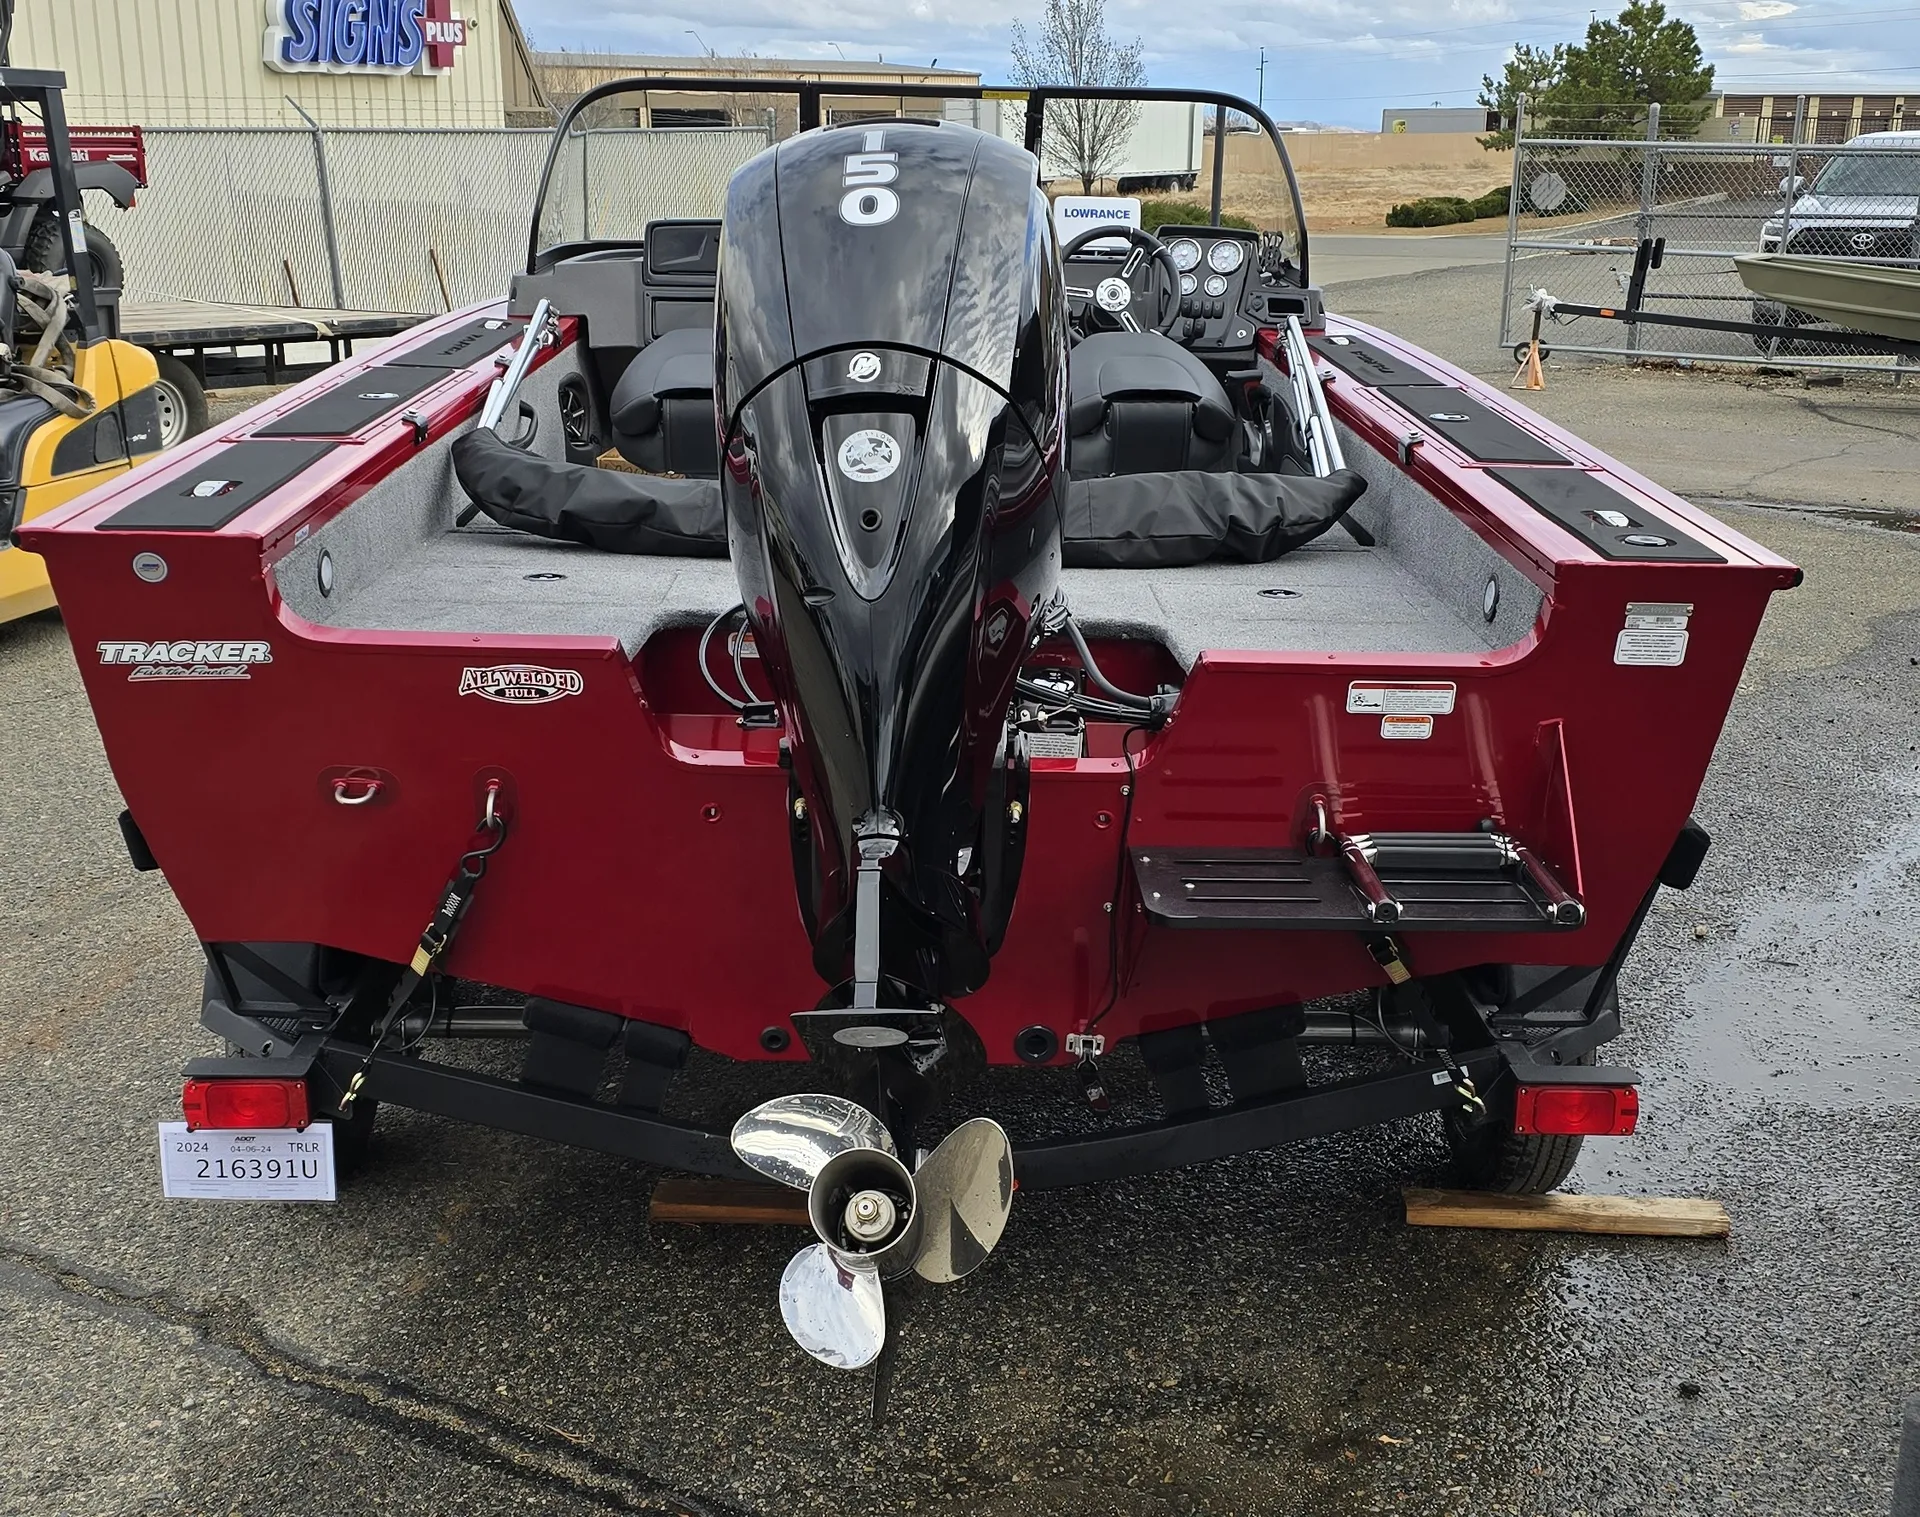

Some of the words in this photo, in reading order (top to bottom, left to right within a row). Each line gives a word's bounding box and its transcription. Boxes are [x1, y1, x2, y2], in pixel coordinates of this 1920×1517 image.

[284, 0, 424, 67] SIGNS
[425, 21, 464, 43] PLUS
[29, 149, 89, 162] Kaaki
[1063, 207, 1131, 220] LOWRANCE
[99, 643, 267, 662] TRACKER
[133, 666, 163, 676] Fish
[165, 667, 186, 676] the
[462, 670, 500, 690] ALL
[501, 670, 580, 692] WELDED
[504, 688, 540, 698] HULL
[176, 1142, 209, 1153] 2024
[230, 1145, 272, 1153] 04-06-24
[288, 1142, 320, 1153] TRLR
[196, 1159, 319, 1179] 216391U
